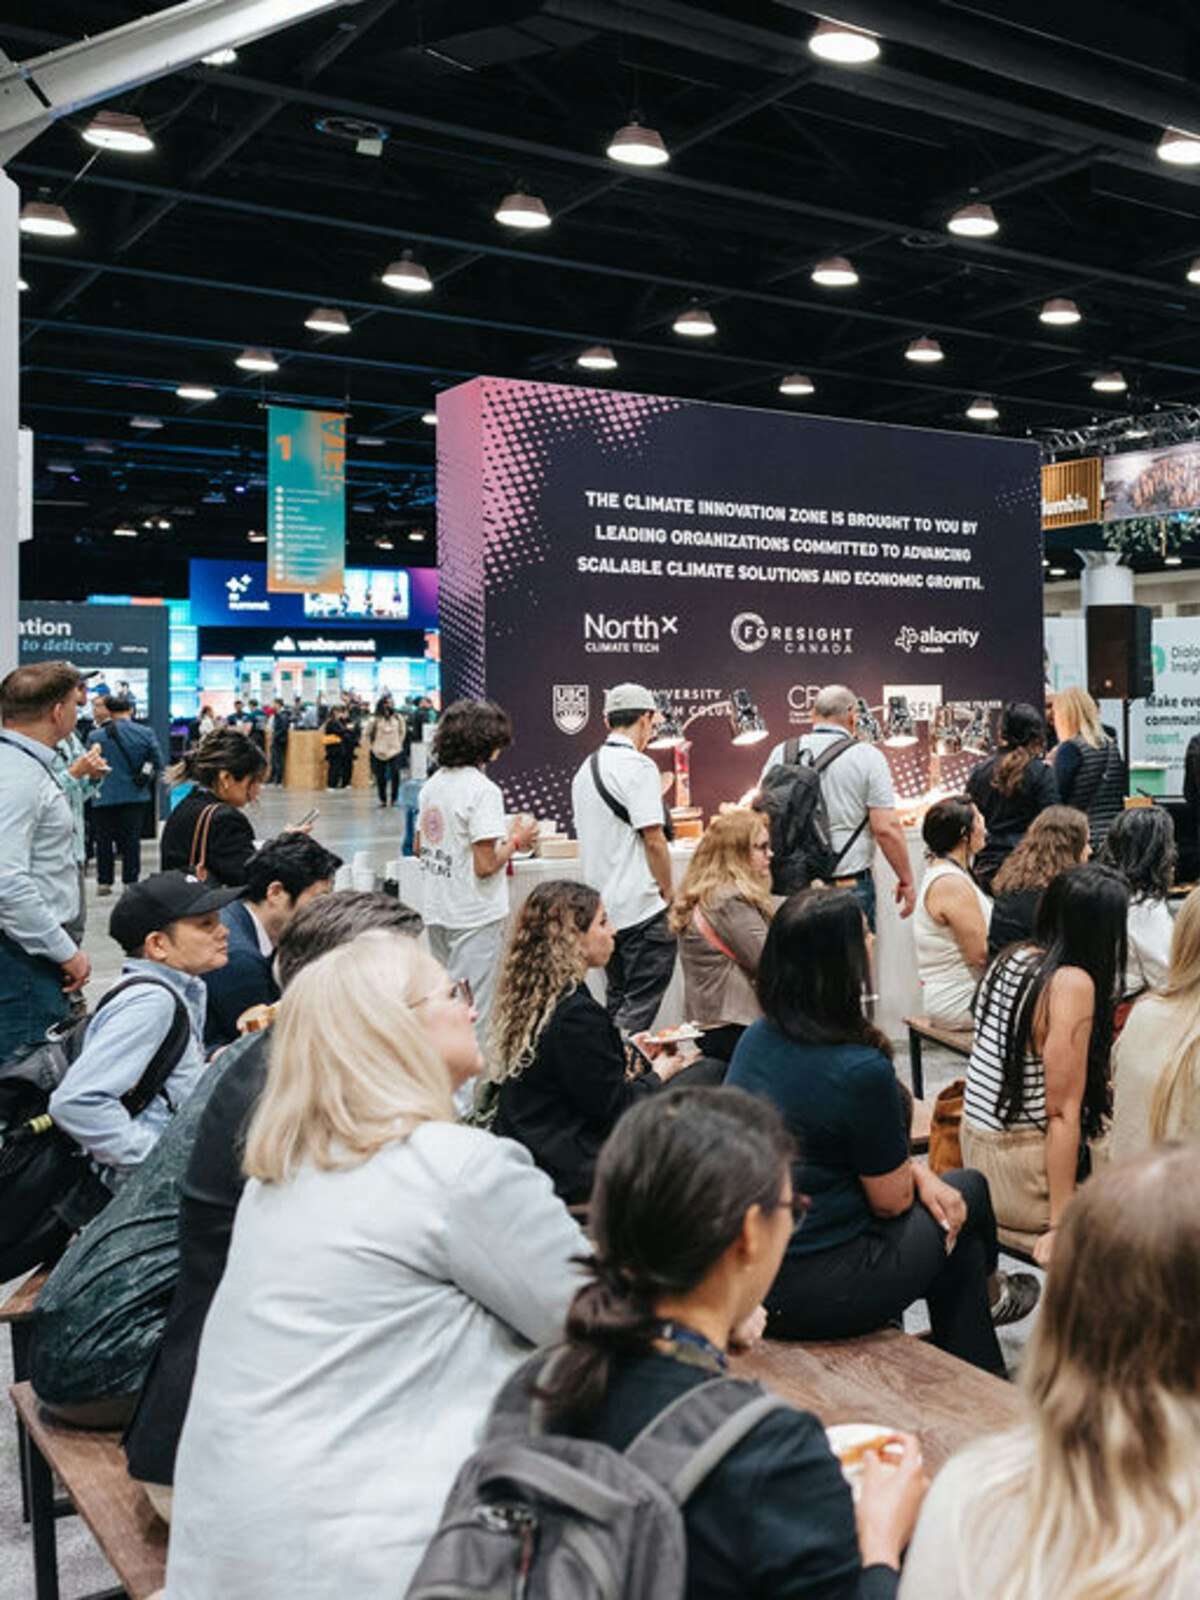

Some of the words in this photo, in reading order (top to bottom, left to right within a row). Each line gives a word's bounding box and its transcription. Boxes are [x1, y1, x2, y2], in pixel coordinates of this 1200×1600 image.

[276, 434, 291, 460] 1
[585, 491, 619, 508] THE
[624, 494, 694, 514] CLIMATE
[698, 500, 786, 522] INNOVATION
[789, 508, 828, 524] ZONE
[832, 511, 845, 526] IS
[848, 512, 911, 531] BROUGHT
[914, 518, 932, 532] TO
[935, 520, 959, 534] YOU
[962, 521, 978, 535] BY
[595, 525, 667, 543] LEADING
[671, 529, 789, 552] ORGANIZATIONS
[793, 538, 878, 557] COMMITTED
[881, 543, 900, 558] TO
[902, 545, 971, 562] ADVANCING
[577, 556, 662, 576] SCALABLE
[667, 561, 735, 580] CLIMATE
[738, 565, 820, 584] SOLUTIONS
[822, 569, 851, 584] AND
[854, 571, 924, 587] ECONOMIC
[926, 574, 985, 590] GROWTH.
[744, 626, 854, 641] FORESIGHT
[920, 626, 980, 648] alacrity
[22, 639, 40, 652] to
[43, 637, 113, 656] delivery
[585, 642, 630, 653] CLIMATE
[632, 642, 660, 653] TECH
[785, 643, 852, 654] CANADA
